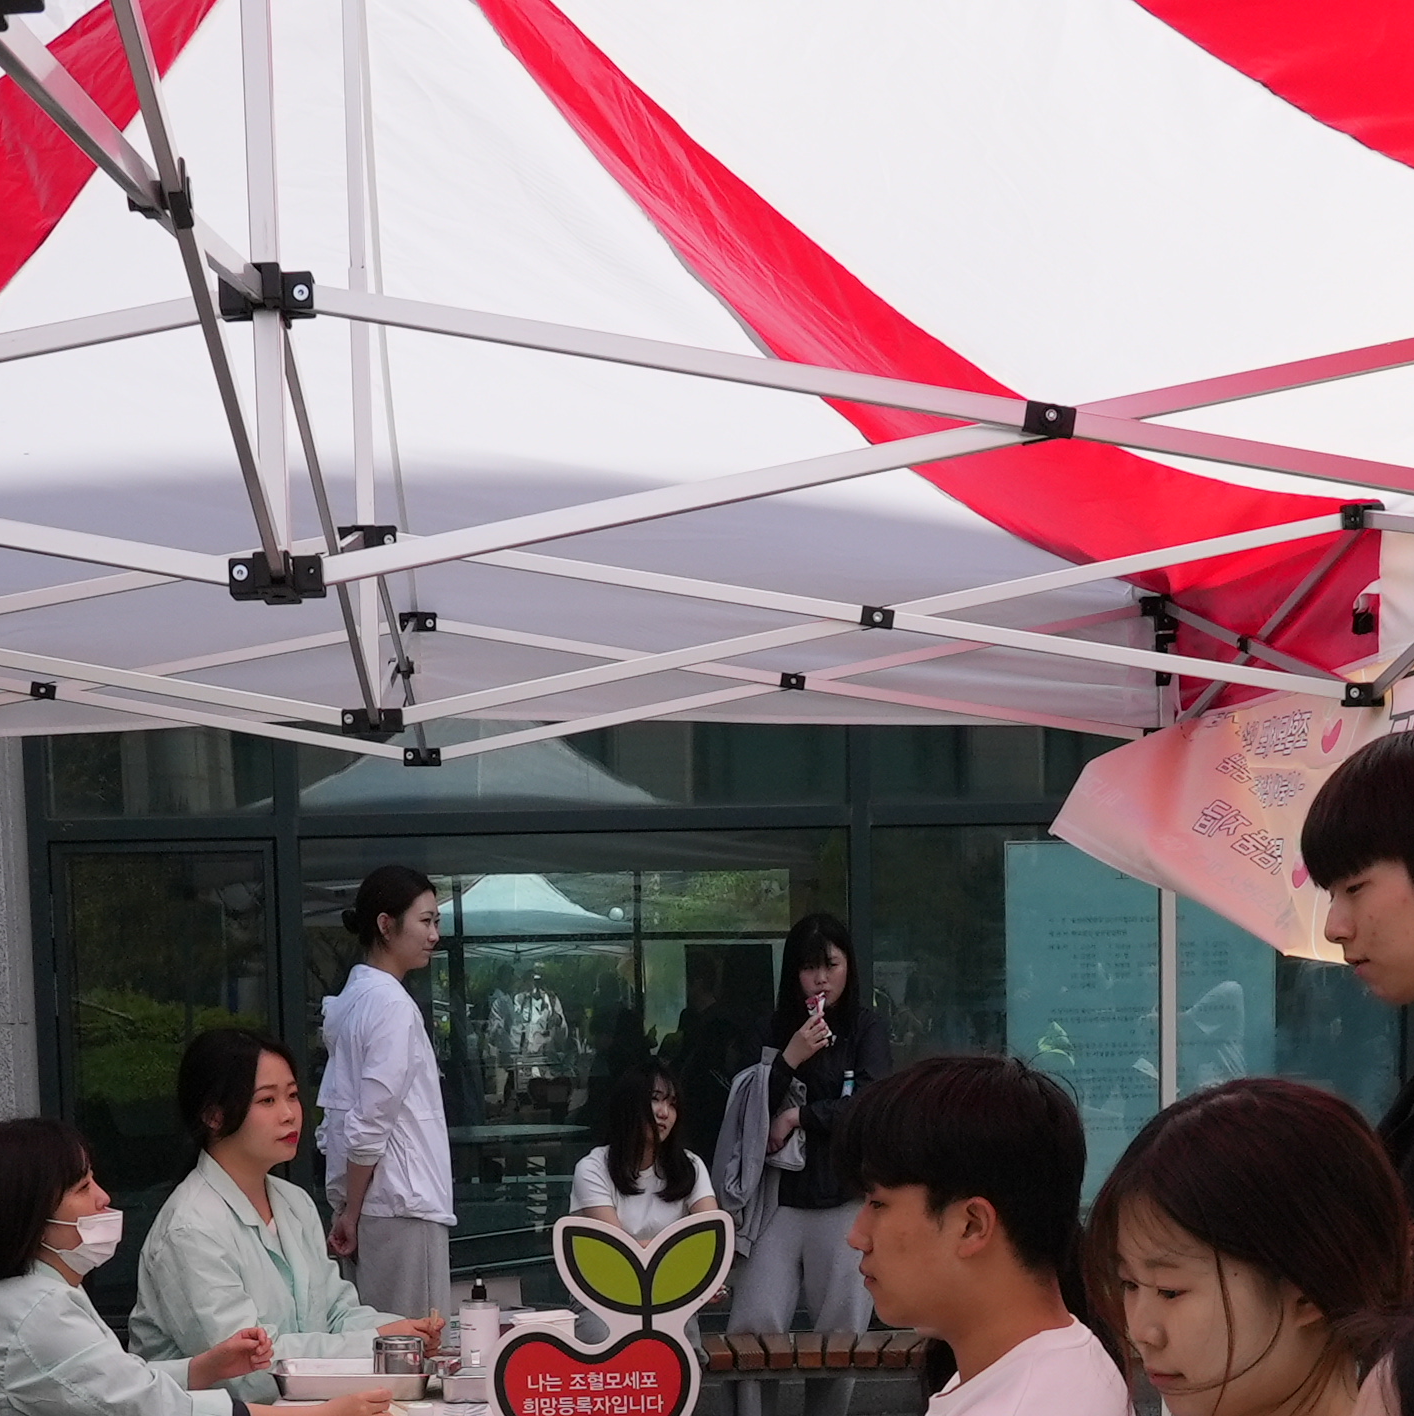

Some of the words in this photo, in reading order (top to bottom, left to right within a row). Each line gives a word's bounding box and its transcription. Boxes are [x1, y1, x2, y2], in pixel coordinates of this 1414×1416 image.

[527, 1374, 563, 1392] 나는
[568, 1371, 658, 1391] 조혈모세포
[522, 1394, 664, 1416] 희망등록자입니다
